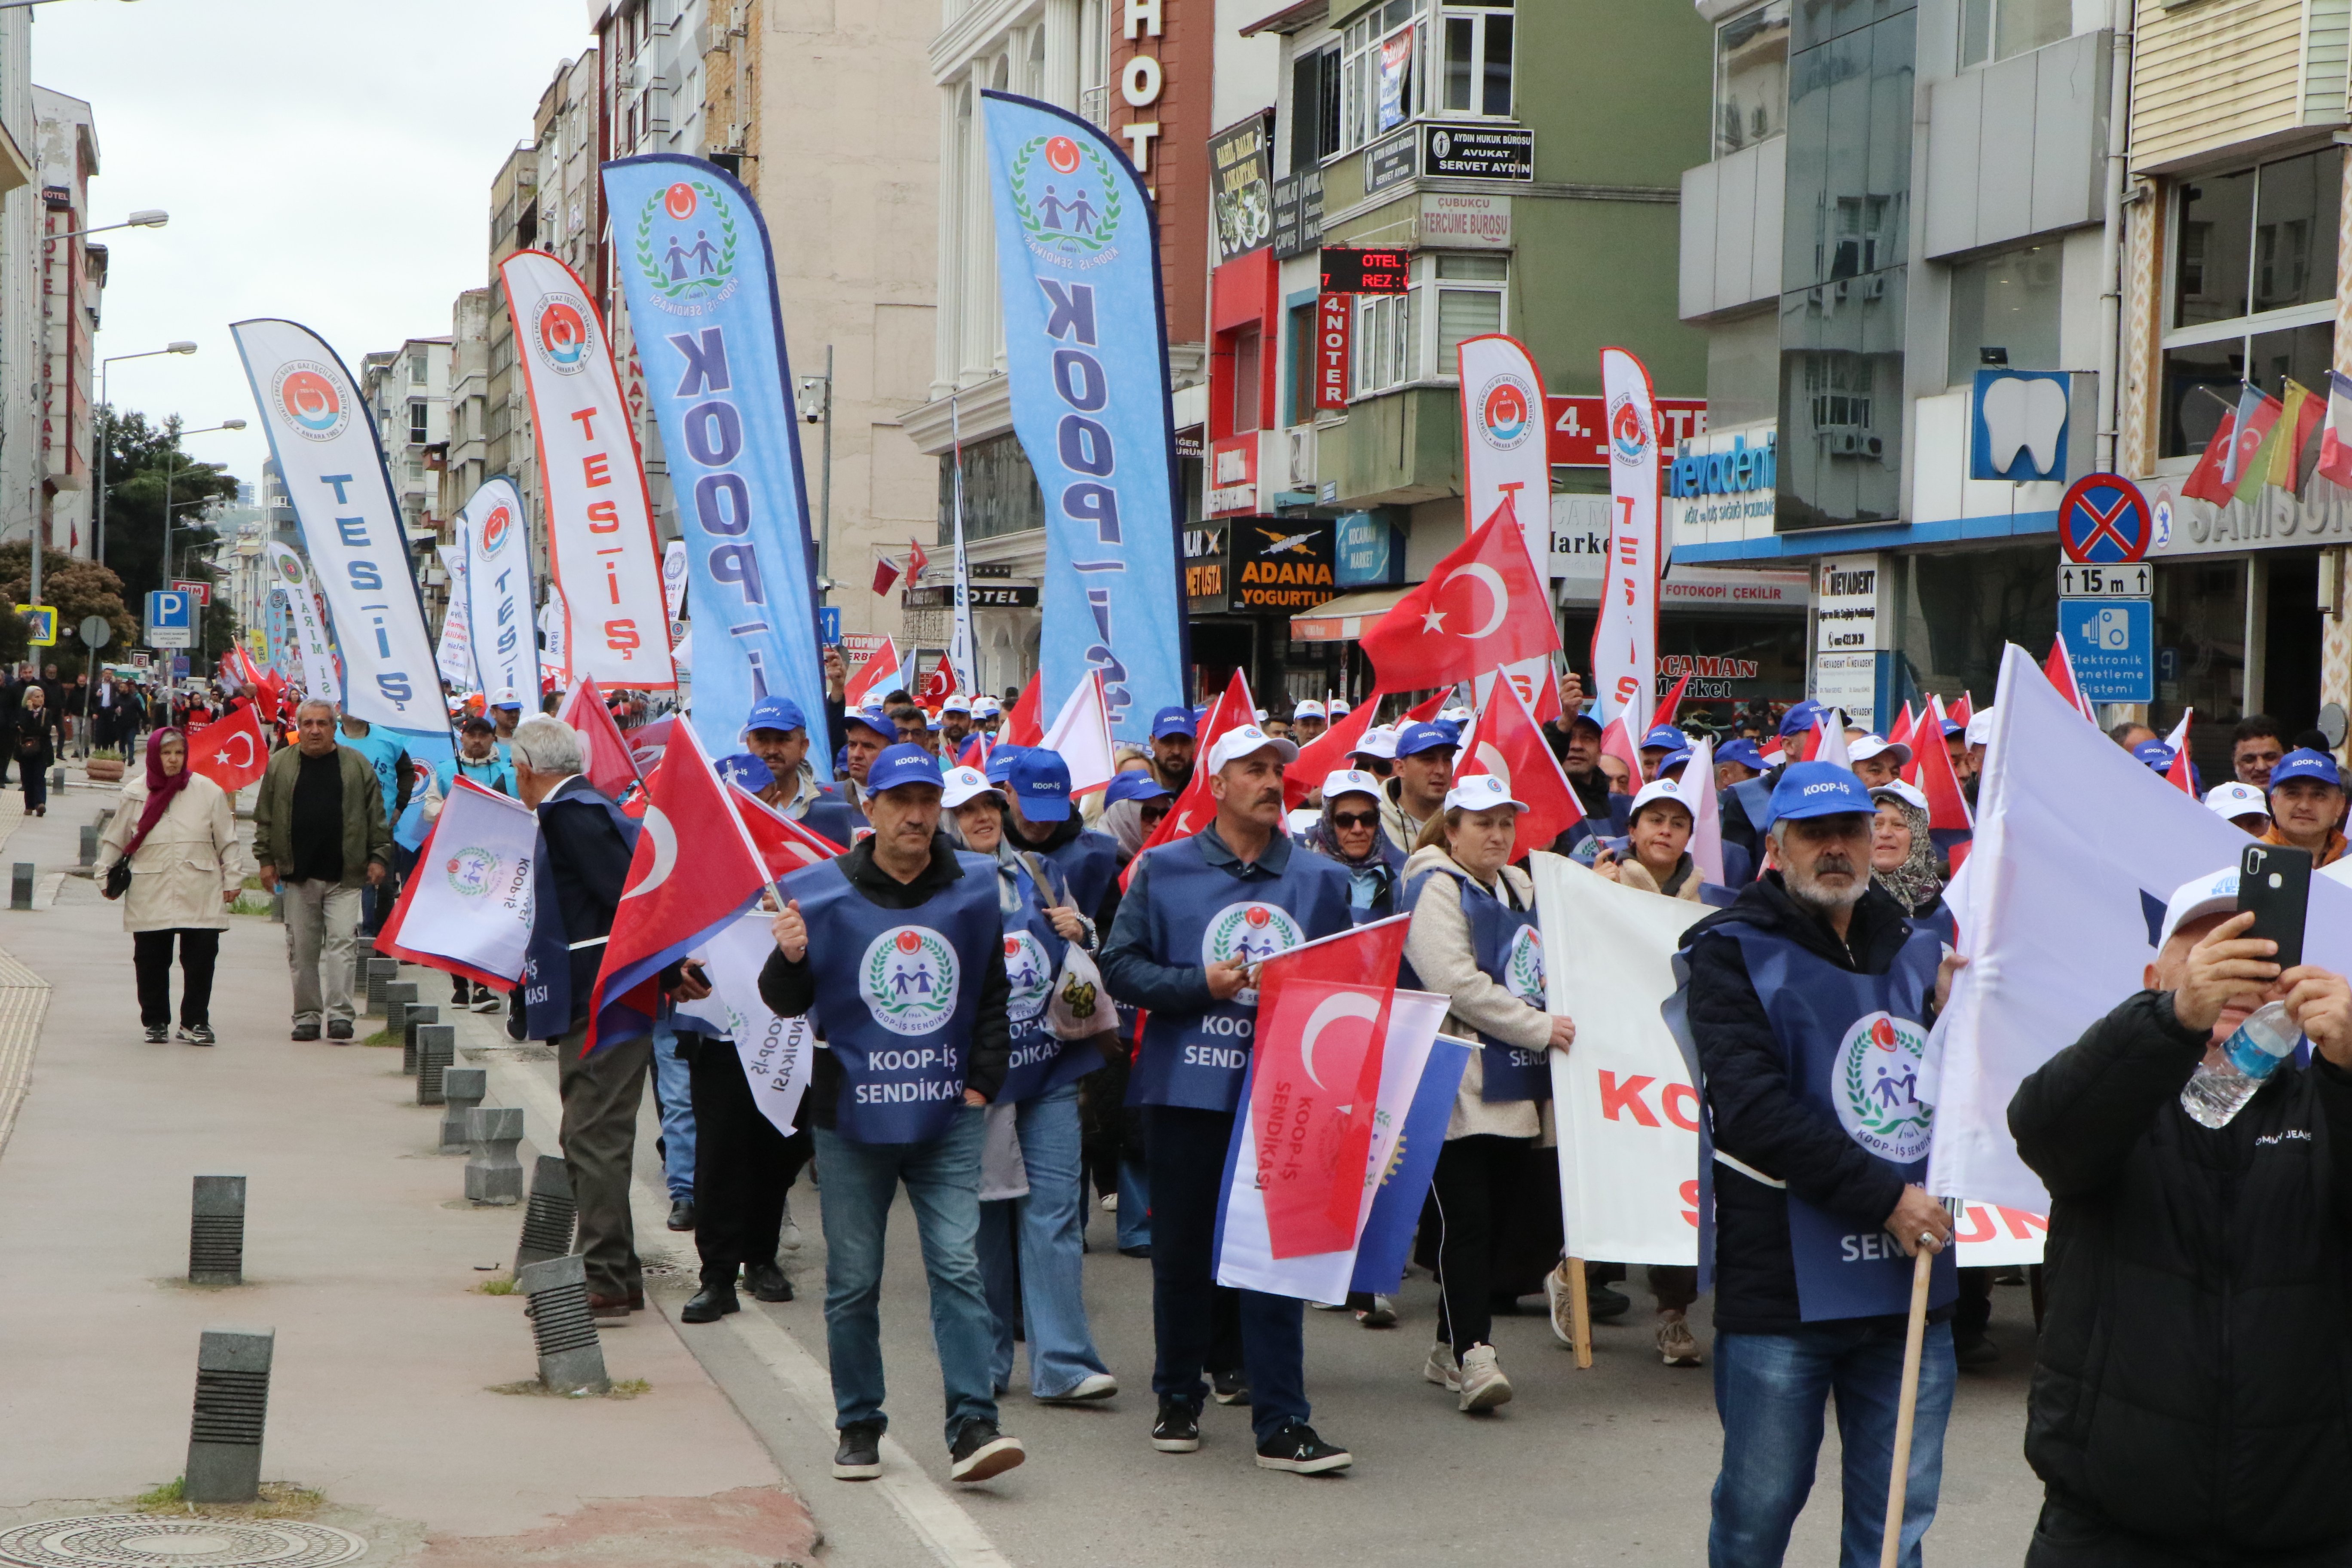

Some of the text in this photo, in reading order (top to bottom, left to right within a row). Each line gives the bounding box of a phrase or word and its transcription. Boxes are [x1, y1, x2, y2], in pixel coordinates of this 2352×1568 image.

[1122, 0, 1161, 201] HOT
[1235, 131, 1256, 158] BALIK
[1454, 133, 1531, 145] AYDIN HUKUK BÜROSU
[1374, 134, 1415, 162] AYDIN HUKUK BÜROSU
[1462, 148, 1510, 158] AVUKAT
[1385, 157, 1399, 167] AVUKAT
[1439, 159, 1530, 174] SERVET AYDIN
[1222, 158, 1259, 194] LOKANTASI
[1376, 164, 1409, 186] SERVET AYDIN
[1275, 181, 1298, 209] AVUKAT
[1438, 197, 1490, 209] ÇUBUKCU
[1424, 209, 1508, 235] TERCÜME BÜROSU
[1362, 254, 1401, 267] OTEL
[1324, 297, 1346, 312] 4.
[1326, 315, 1344, 401] NOTER
[1556, 406, 1591, 438] 4.
[302, 430, 326, 439] ANKARA
[1176, 437, 1199, 448] İĞER
[1176, 446, 1204, 456] ÜRÜM
[1493, 440, 1510, 448] ANKARA
[572, 407, 640, 661] TES-İŞ
[1351, 551, 1374, 570] MARKET
[1203, 564, 1221, 595] USTA
[1240, 562, 1333, 585] ADANA
[2082, 570, 2124, 593] 15 m
[1831, 570, 1875, 596] NEVADENT
[320, 474, 412, 711] TES-İŞ
[1666, 585, 1782, 600] FOTOKOPİ ÇEKİLİR
[160, 594, 182, 625] P
[495, 567, 518, 688] TES-İ
[1851, 659, 1873, 668] NEVADENT
[2070, 654, 2142, 665] Elektronik
[2074, 669, 2144, 680] enetleme
[2079, 683, 2133, 693] Sistemi
[1851, 708, 1872, 717] NEVADENT
[2144, 747, 2168, 756] KOOP-İŞ
[895, 756, 928, 767] KOOP-İŞ
[2292, 759, 2323, 769] KOOP-İŞ
[722, 767, 748, 780] KOP-İŞ
[1032, 781, 1061, 790] KOOP-İŞ
[1804, 781, 1850, 797] KOOP-İŞ
[874, 1004, 954, 1031] KOOP-İŞ SENDİKASI
[869, 1044, 958, 1072] KOOP-İŞ
[1509, 1050, 1547, 1067] SEND
[855, 1077, 963, 1104] SENDİKASI
[1254, 1081, 1292, 1191] SENDİKASI
[1278, 1096, 1314, 1181] KOOP-İŞ
[1856, 1129, 1905, 1158] KOOP-İŞ
[2255, 1131, 2283, 1146] OMMY
